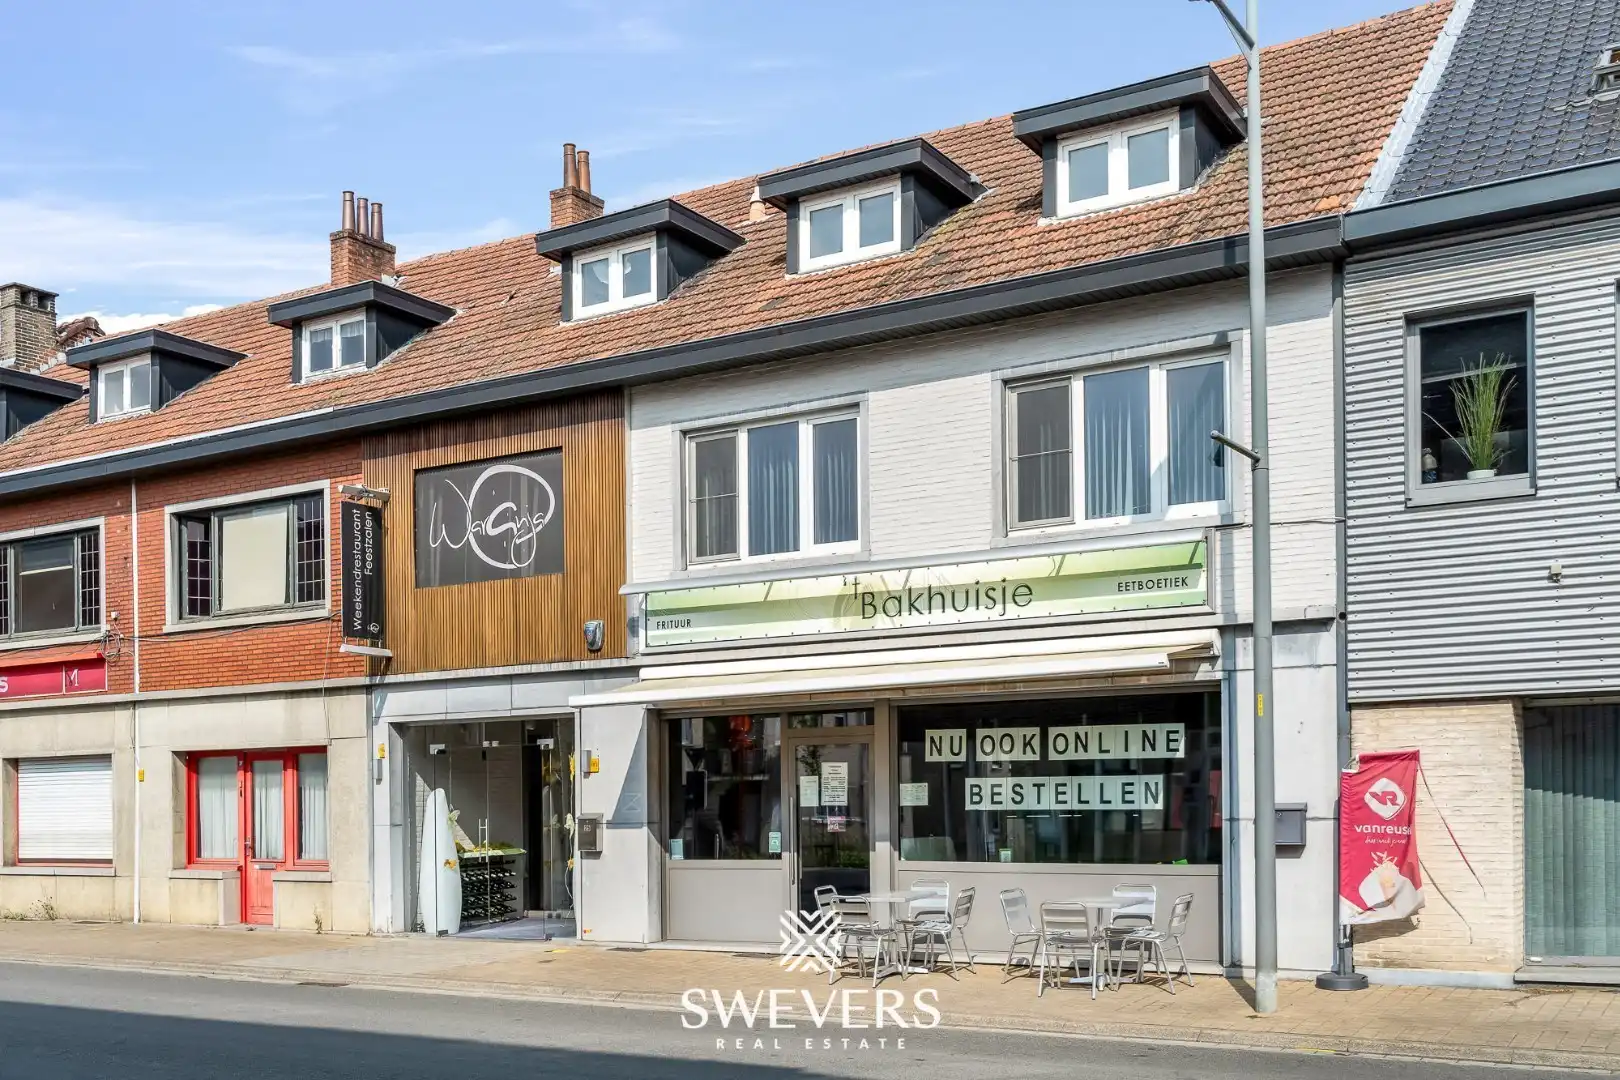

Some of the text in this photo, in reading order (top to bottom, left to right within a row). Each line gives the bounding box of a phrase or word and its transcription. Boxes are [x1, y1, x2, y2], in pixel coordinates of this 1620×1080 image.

[364, 511, 373, 576] Feestzalen
[352, 508, 361, 631] Weekendrestaurant
[1117, 576, 1189, 593] EETBOETIEK
[862, 577, 1033, 620] Bakhuisje
[656, 619, 692, 630] FRITUUR
[928, 729, 1180, 758] NU OOK ONLINE
[969, 781, 1160, 806] BESTELLEN
[1354, 824, 1412, 836] vanreus
